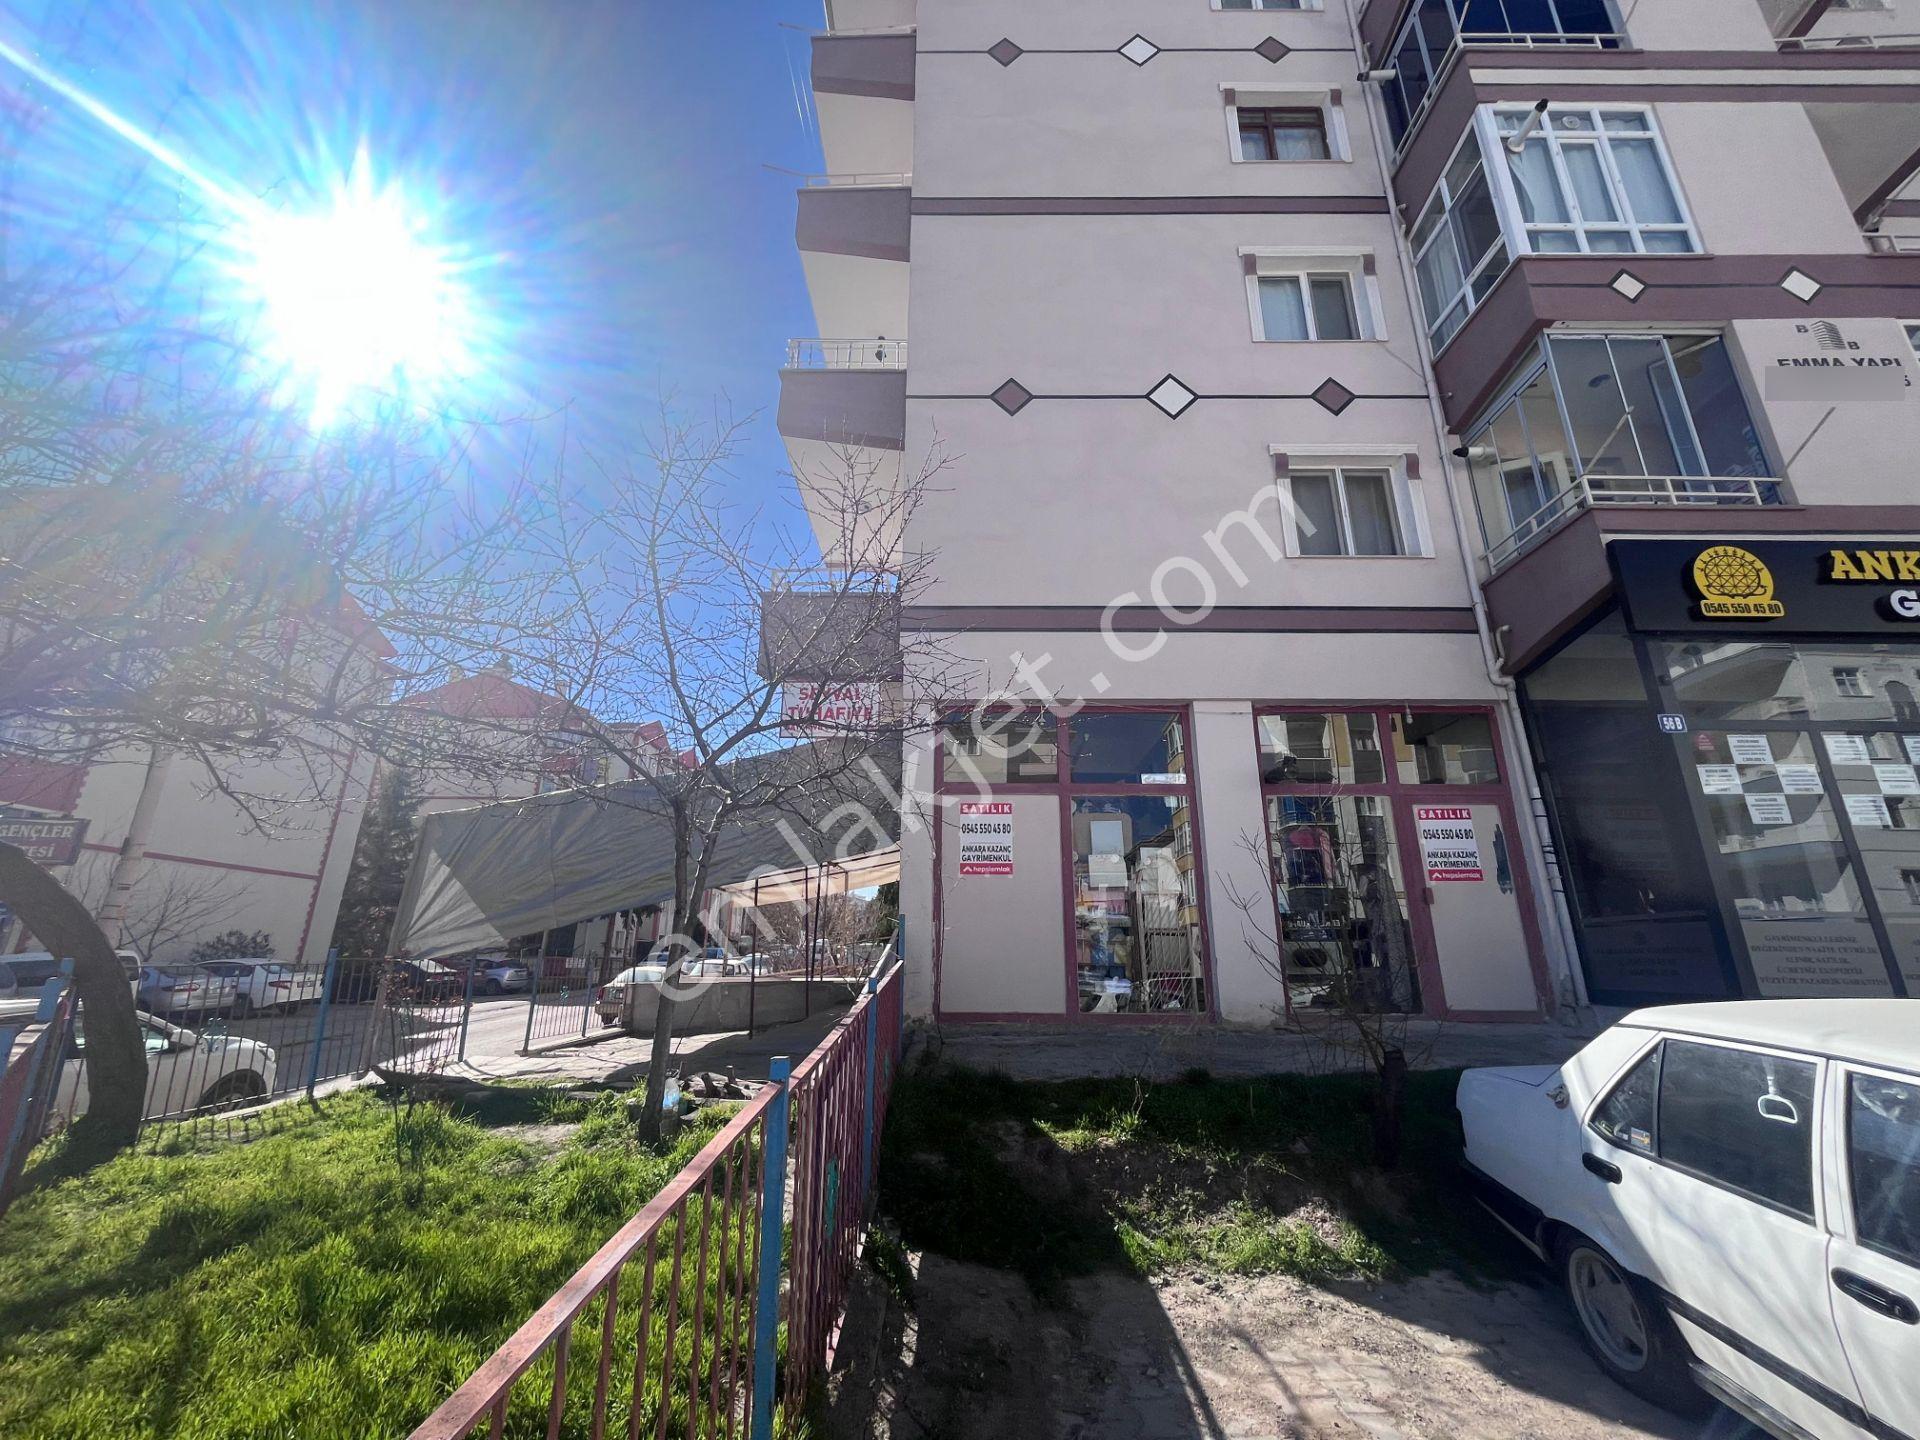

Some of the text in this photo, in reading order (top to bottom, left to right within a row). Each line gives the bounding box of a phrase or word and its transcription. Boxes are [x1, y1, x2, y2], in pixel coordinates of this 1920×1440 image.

[1704, 602, 1782, 614] 0545 550 45 80
[1662, 716, 1683, 730] 56 B
[962, 804, 1011, 813] SATILIK
[1420, 809, 1470, 819] SATILIK
[961, 823, 1012, 834] 0545 550 45 80
[1422, 829, 1474, 840] 0545 550 45 80
[961, 845, 1012, 854] ANKARA KAZANÇ
[1427, 851, 1478, 860] ANKARA KAZANÇ
